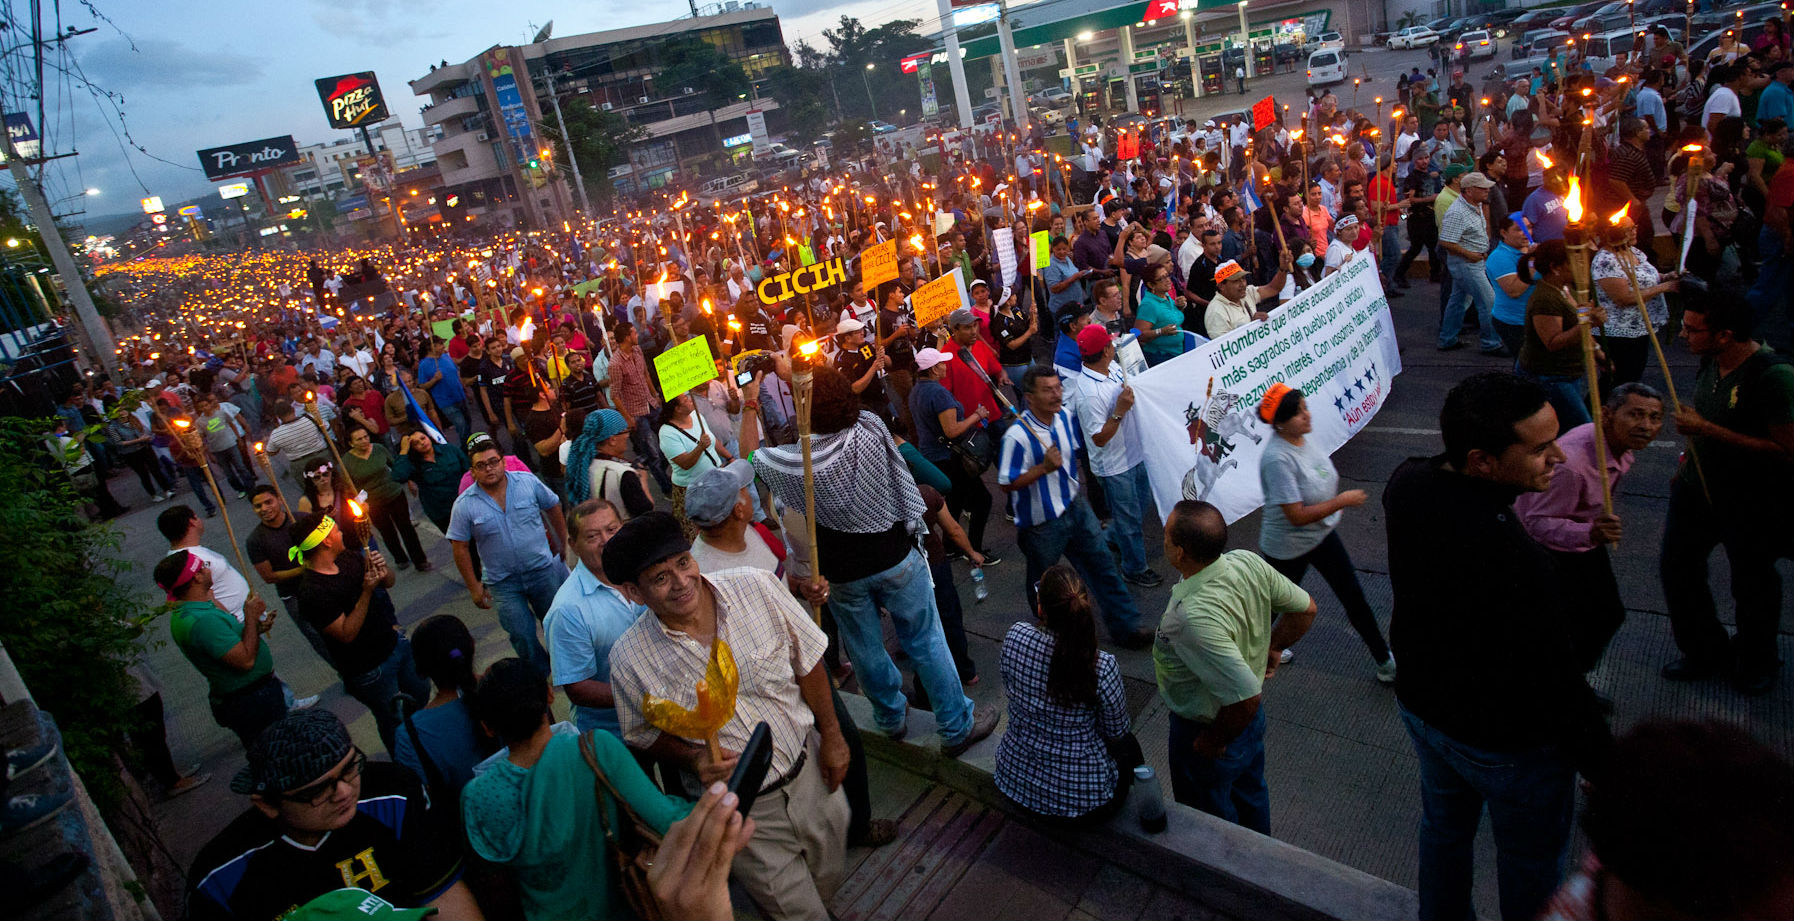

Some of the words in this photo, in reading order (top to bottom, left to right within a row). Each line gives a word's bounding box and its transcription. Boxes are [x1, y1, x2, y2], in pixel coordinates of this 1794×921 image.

[331, 86, 373, 120] Pizza
[343, 97, 373, 122] Hut
[211, 146, 287, 169] Pronto
[757, 256, 847, 305] CICIH
[1271, 313, 1286, 334] que
[1221, 365, 1247, 389] más
[1247, 338, 1290, 373] sagrados
[1290, 326, 1304, 346] del
[1303, 312, 1328, 342] pueblo
[1326, 307, 1337, 326] por
[1336, 301, 1345, 315] un
[1314, 340, 1331, 358] Con
[335, 846, 391, 893] H
